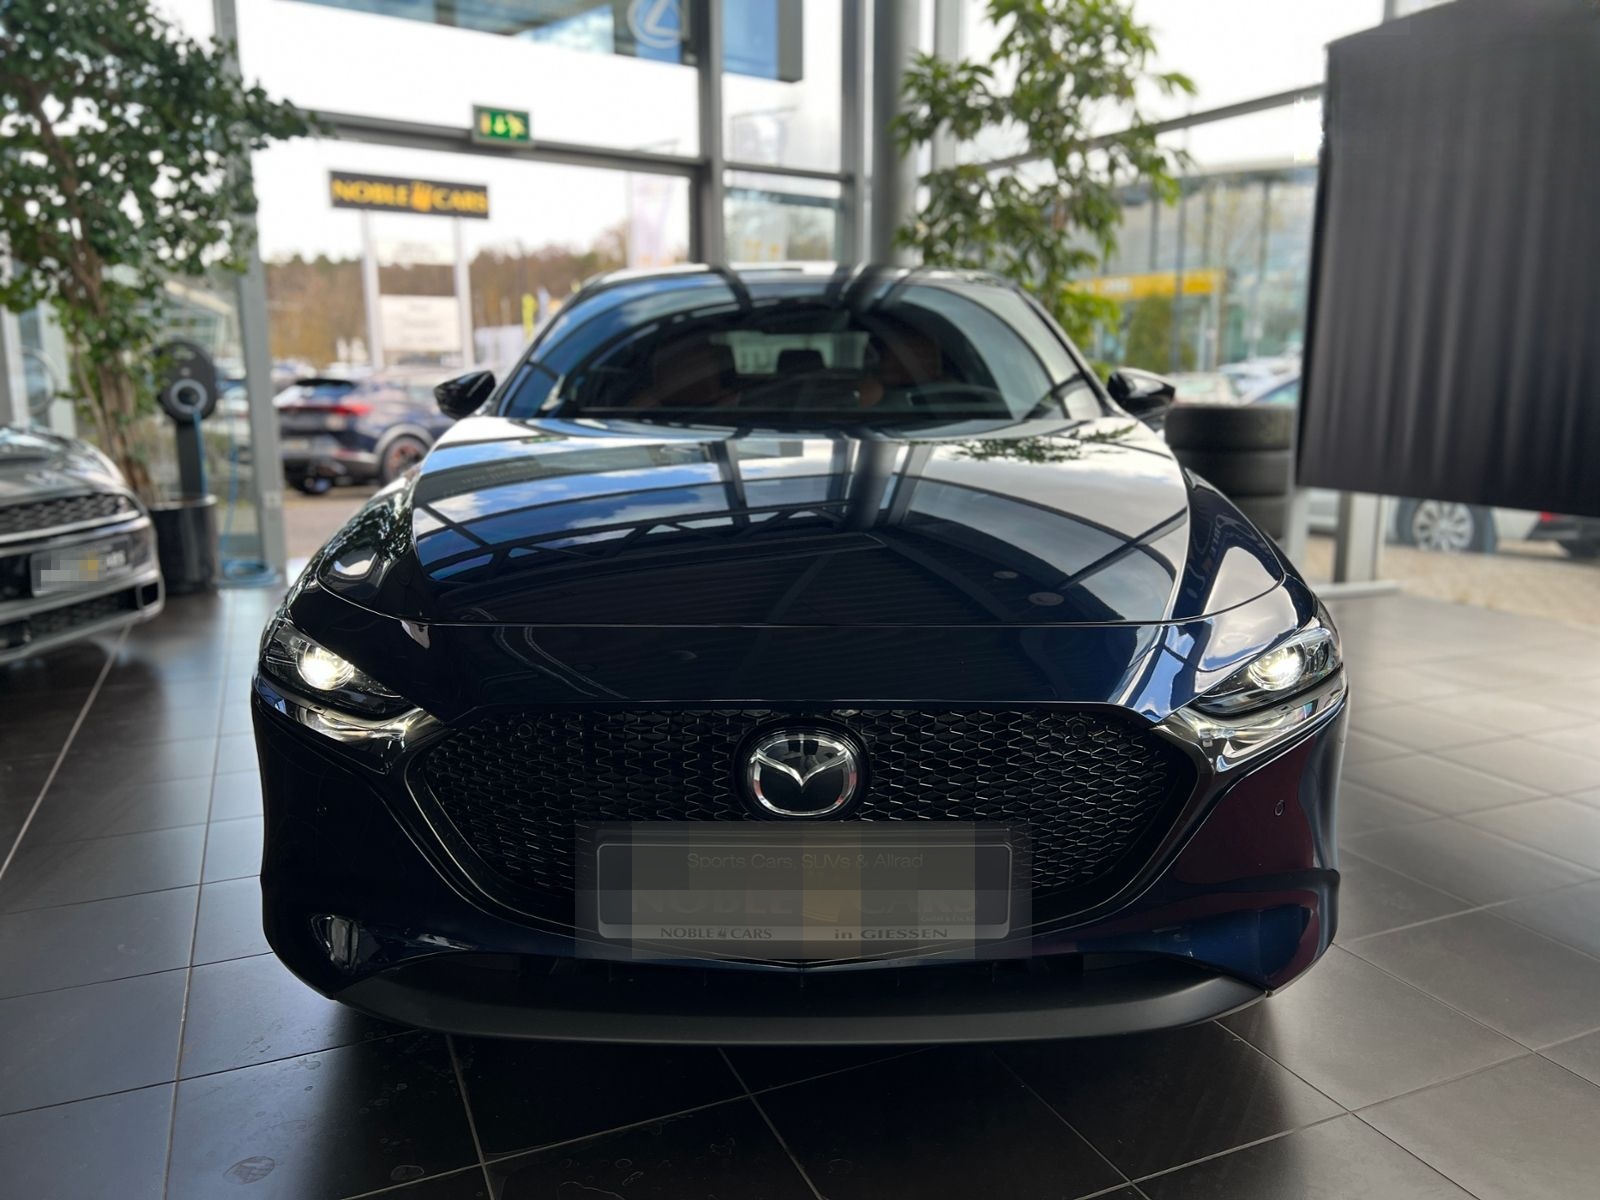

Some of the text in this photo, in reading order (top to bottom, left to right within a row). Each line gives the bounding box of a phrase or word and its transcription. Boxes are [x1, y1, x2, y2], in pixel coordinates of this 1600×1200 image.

[687, 853, 746, 871] Sports
[801, 853, 851, 869] SUVs
[855, 854, 869, 869] &
[873, 853, 924, 869] Allrad
[660, 927, 773, 940] NOBLE CARS
[834, 928, 948, 940] in GIESSEN
